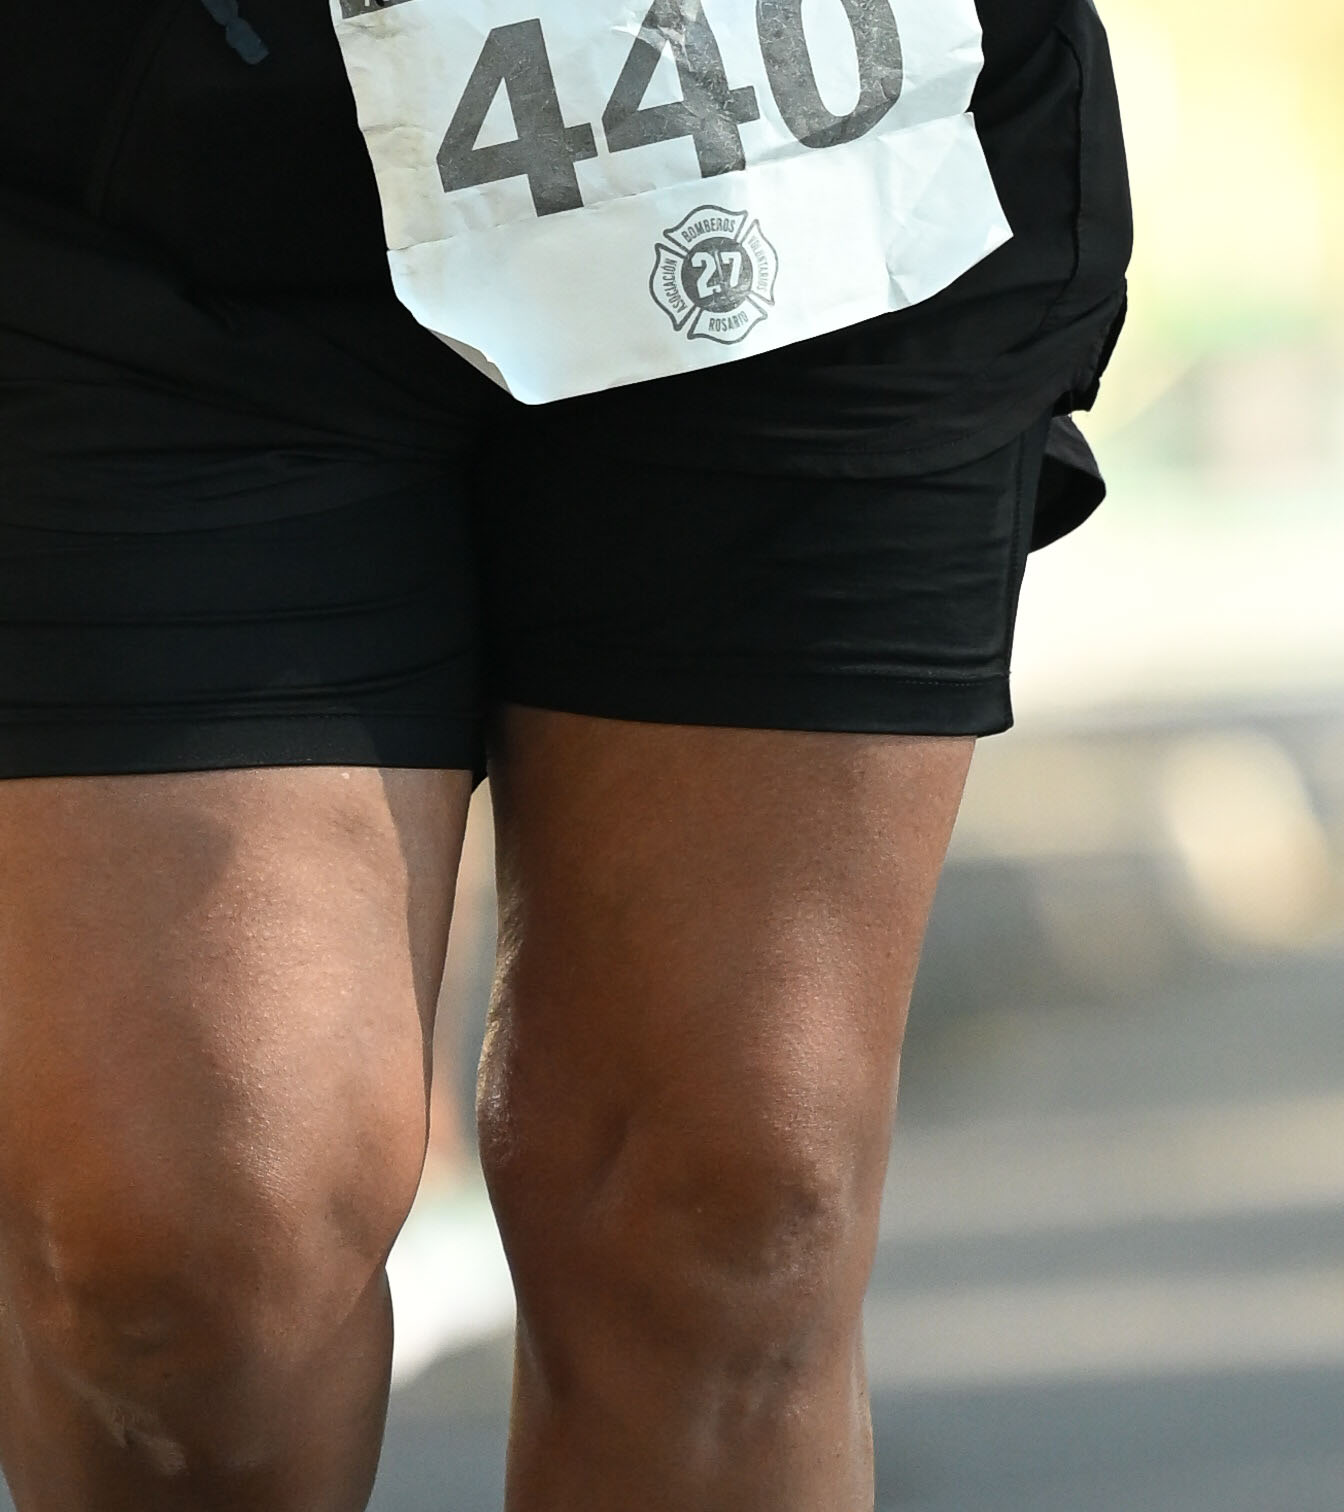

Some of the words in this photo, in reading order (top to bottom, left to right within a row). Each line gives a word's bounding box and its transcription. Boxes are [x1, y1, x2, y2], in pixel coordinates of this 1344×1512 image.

[681, 217, 736, 243] BOMBEROS
[690, 251, 743, 299] 27
[708, 310, 749, 333] ROSARIO
